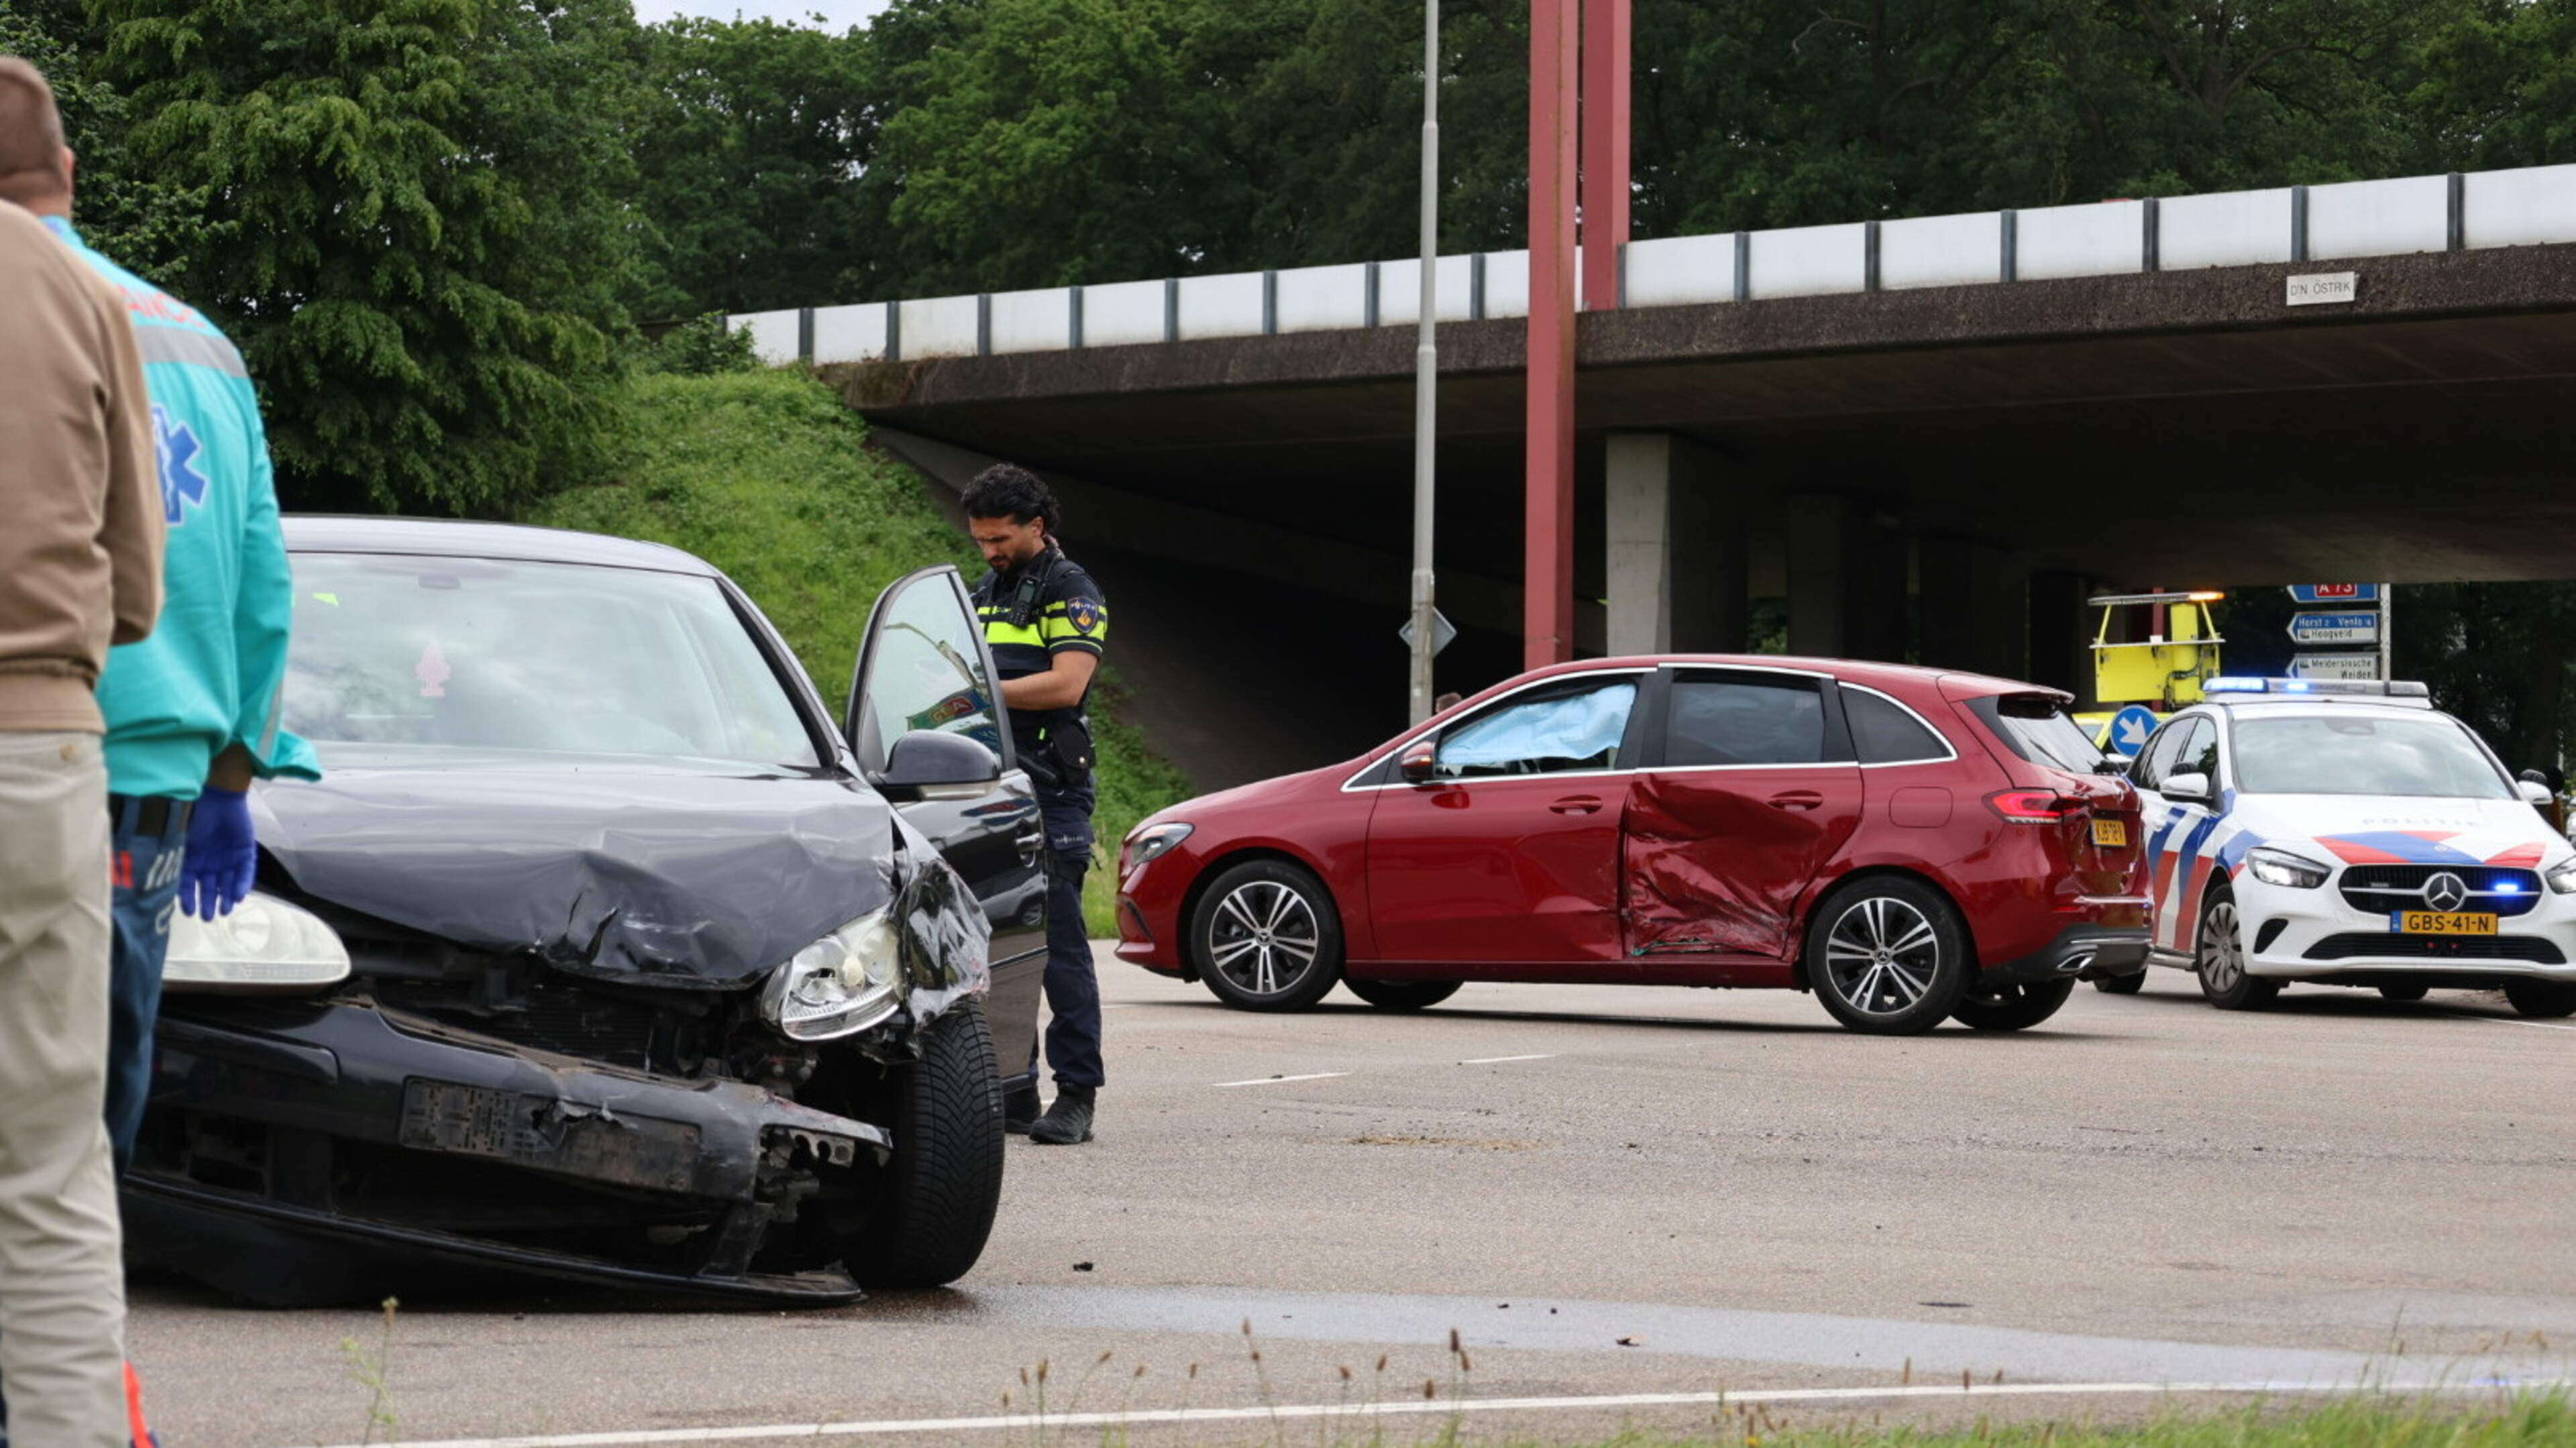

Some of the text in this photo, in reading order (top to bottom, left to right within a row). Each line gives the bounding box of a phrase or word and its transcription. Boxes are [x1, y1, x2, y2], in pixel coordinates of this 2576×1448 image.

[2319, 584, 2330, 593] A
[2299, 617, 2322, 627] Horst
[2339, 616, 2363, 626] Venlo
[2408, 915, 2489, 932] GBS-41-N
